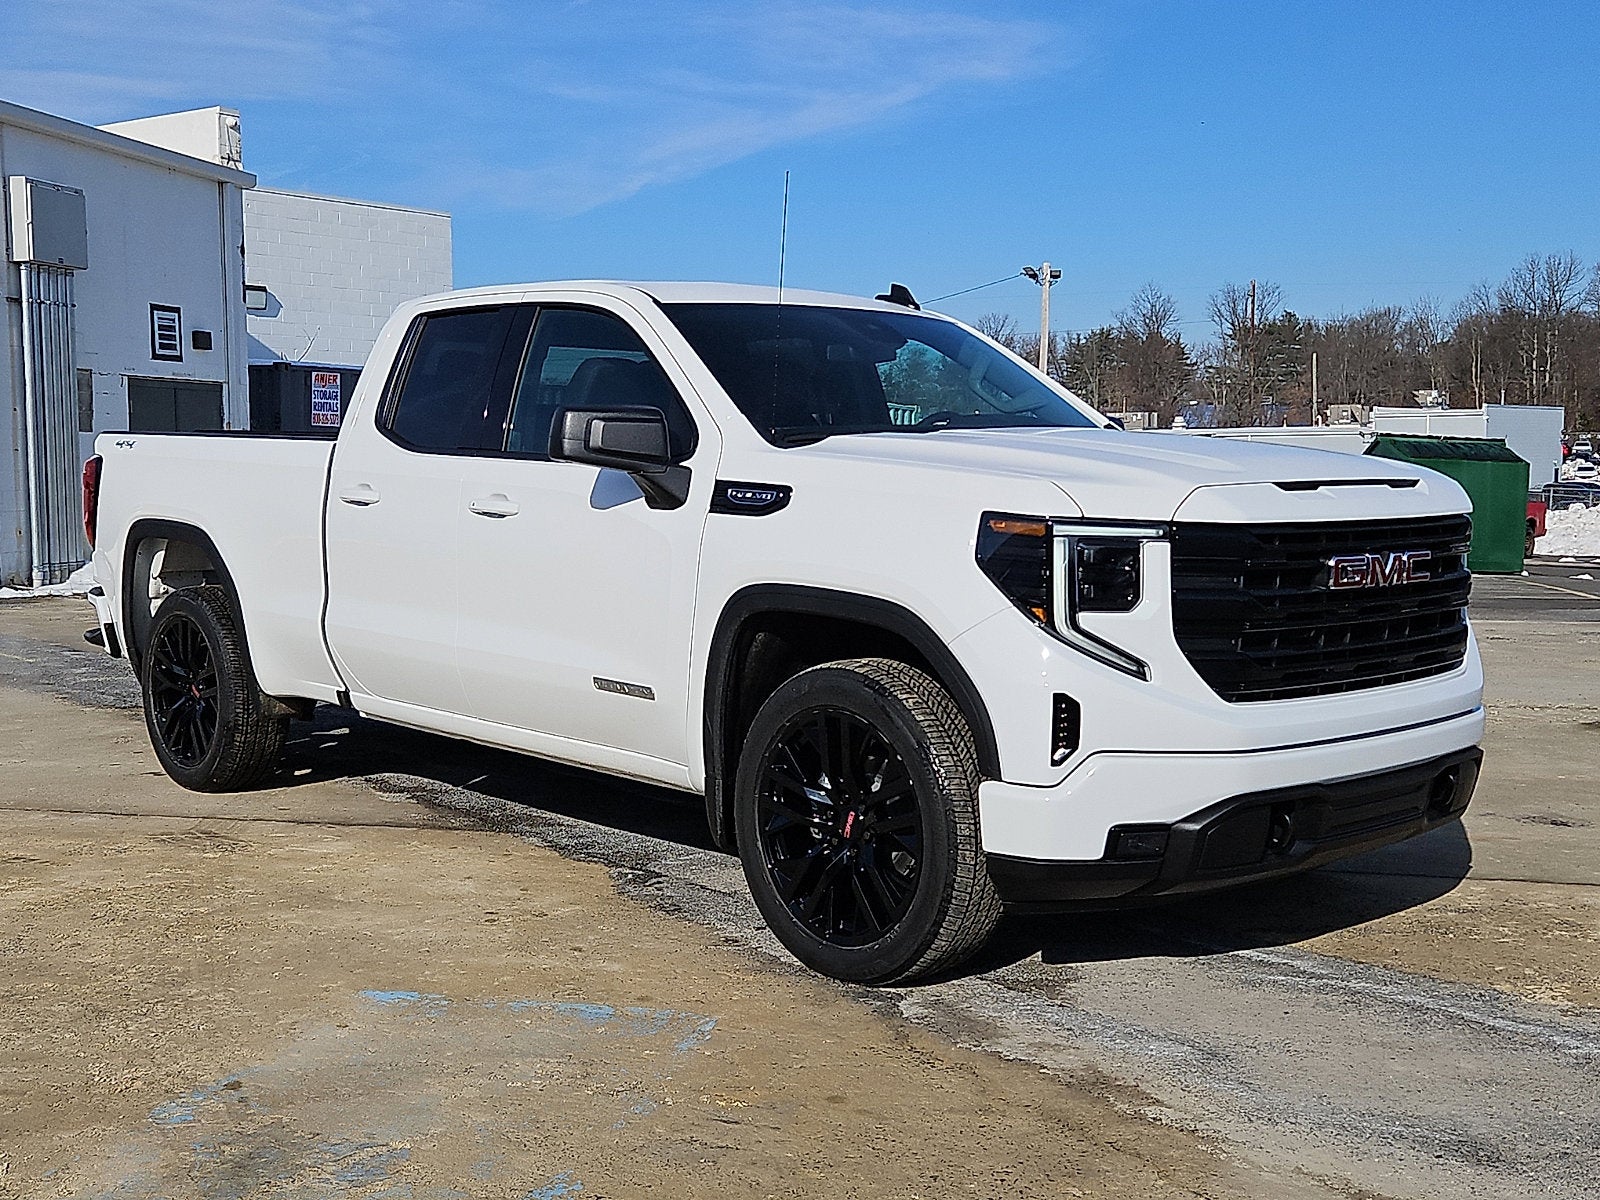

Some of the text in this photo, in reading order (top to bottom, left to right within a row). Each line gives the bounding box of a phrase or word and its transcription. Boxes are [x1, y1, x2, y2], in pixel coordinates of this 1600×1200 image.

[313, 390, 338, 401] STORAGE
[313, 401, 338, 412] RENTALS
[1328, 551, 1431, 589] GMC
